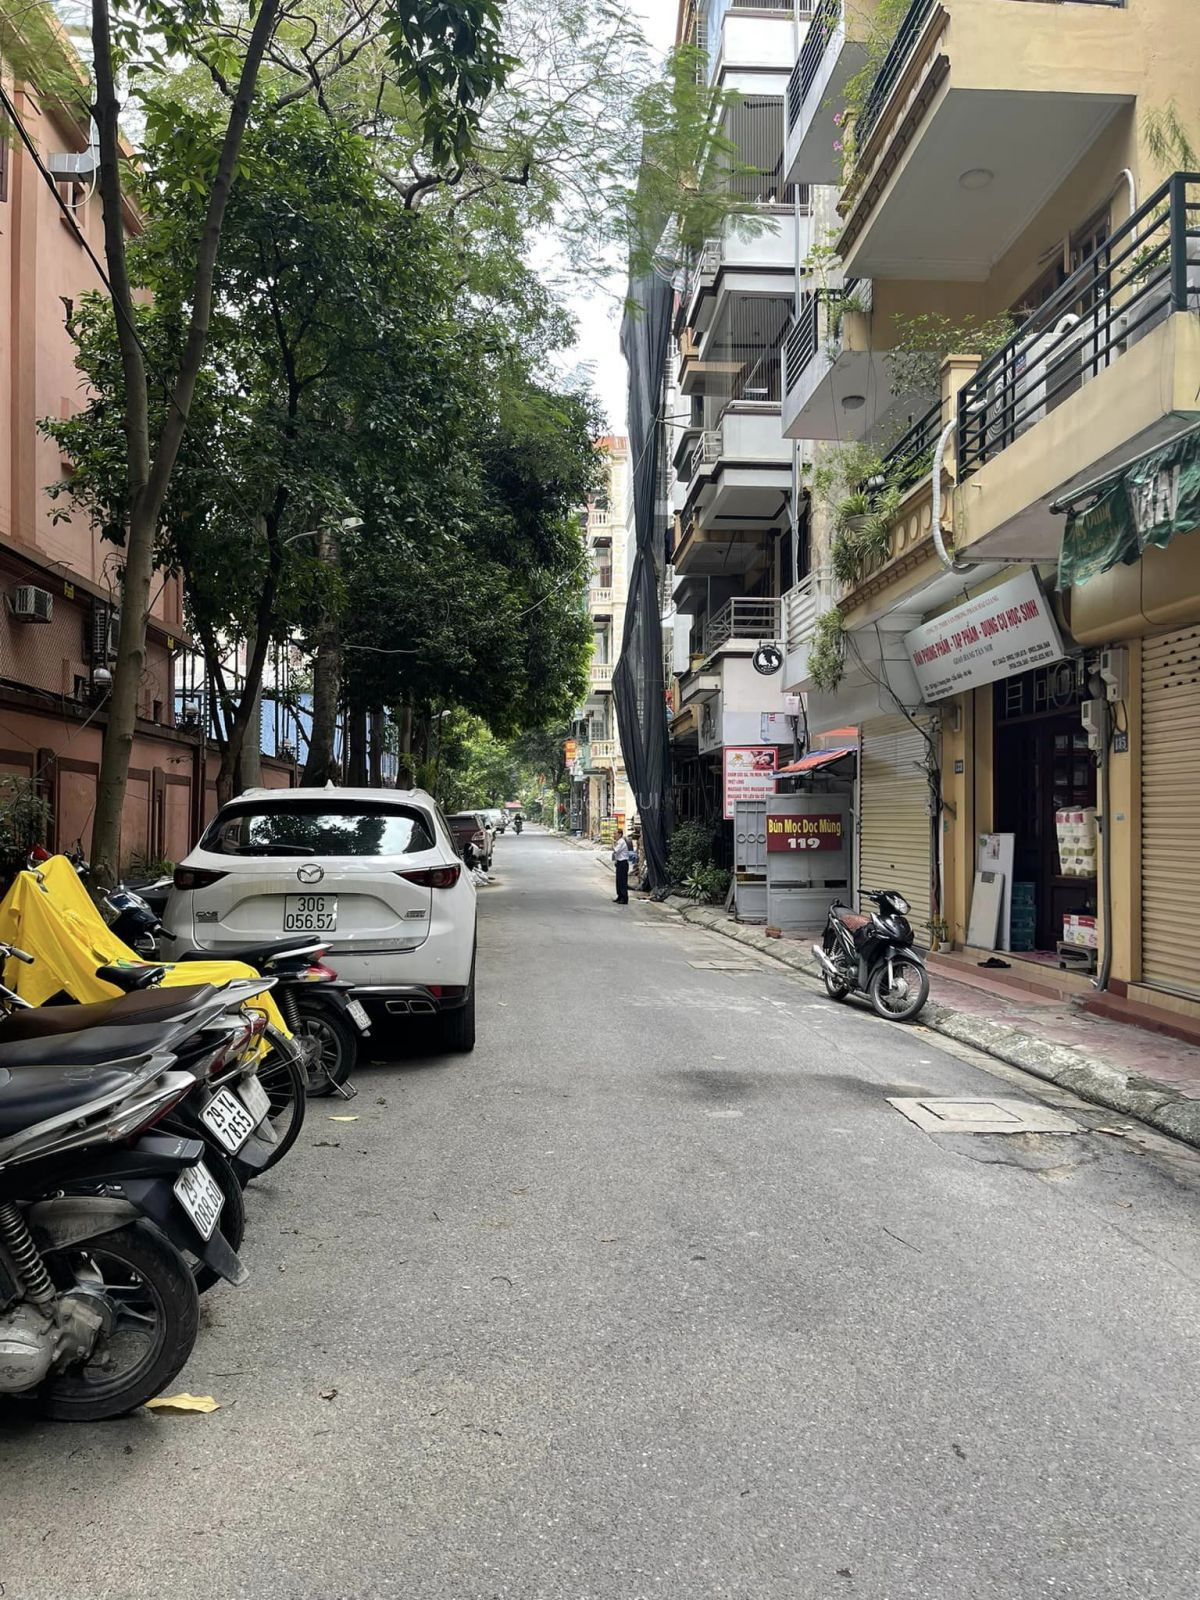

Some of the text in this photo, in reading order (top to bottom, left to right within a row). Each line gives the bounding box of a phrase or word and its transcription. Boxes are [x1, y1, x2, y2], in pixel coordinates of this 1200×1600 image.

[935, 633, 952, 657] PHẨM
[951, 632, 963, 652] TẠP
[961, 619, 980, 646] PHẨM
[980, 616, 999, 639] DỤNG
[996, 612, 1009, 633] CỤ
[1005, 606, 1022, 629] HỌC
[1019, 599, 1040, 621] SINH
[768, 818, 841, 836] Bún Mọc Dọc Mùng
[787, 838, 820, 848] 119
[297, 896, 325, 912] 30G
[286, 914, 334, 930] 056.57
[206, 1093, 237, 1128] 29-Y4
[222, 1111, 252, 1147] 7855
[194, 1179, 221, 1233] 088.60
